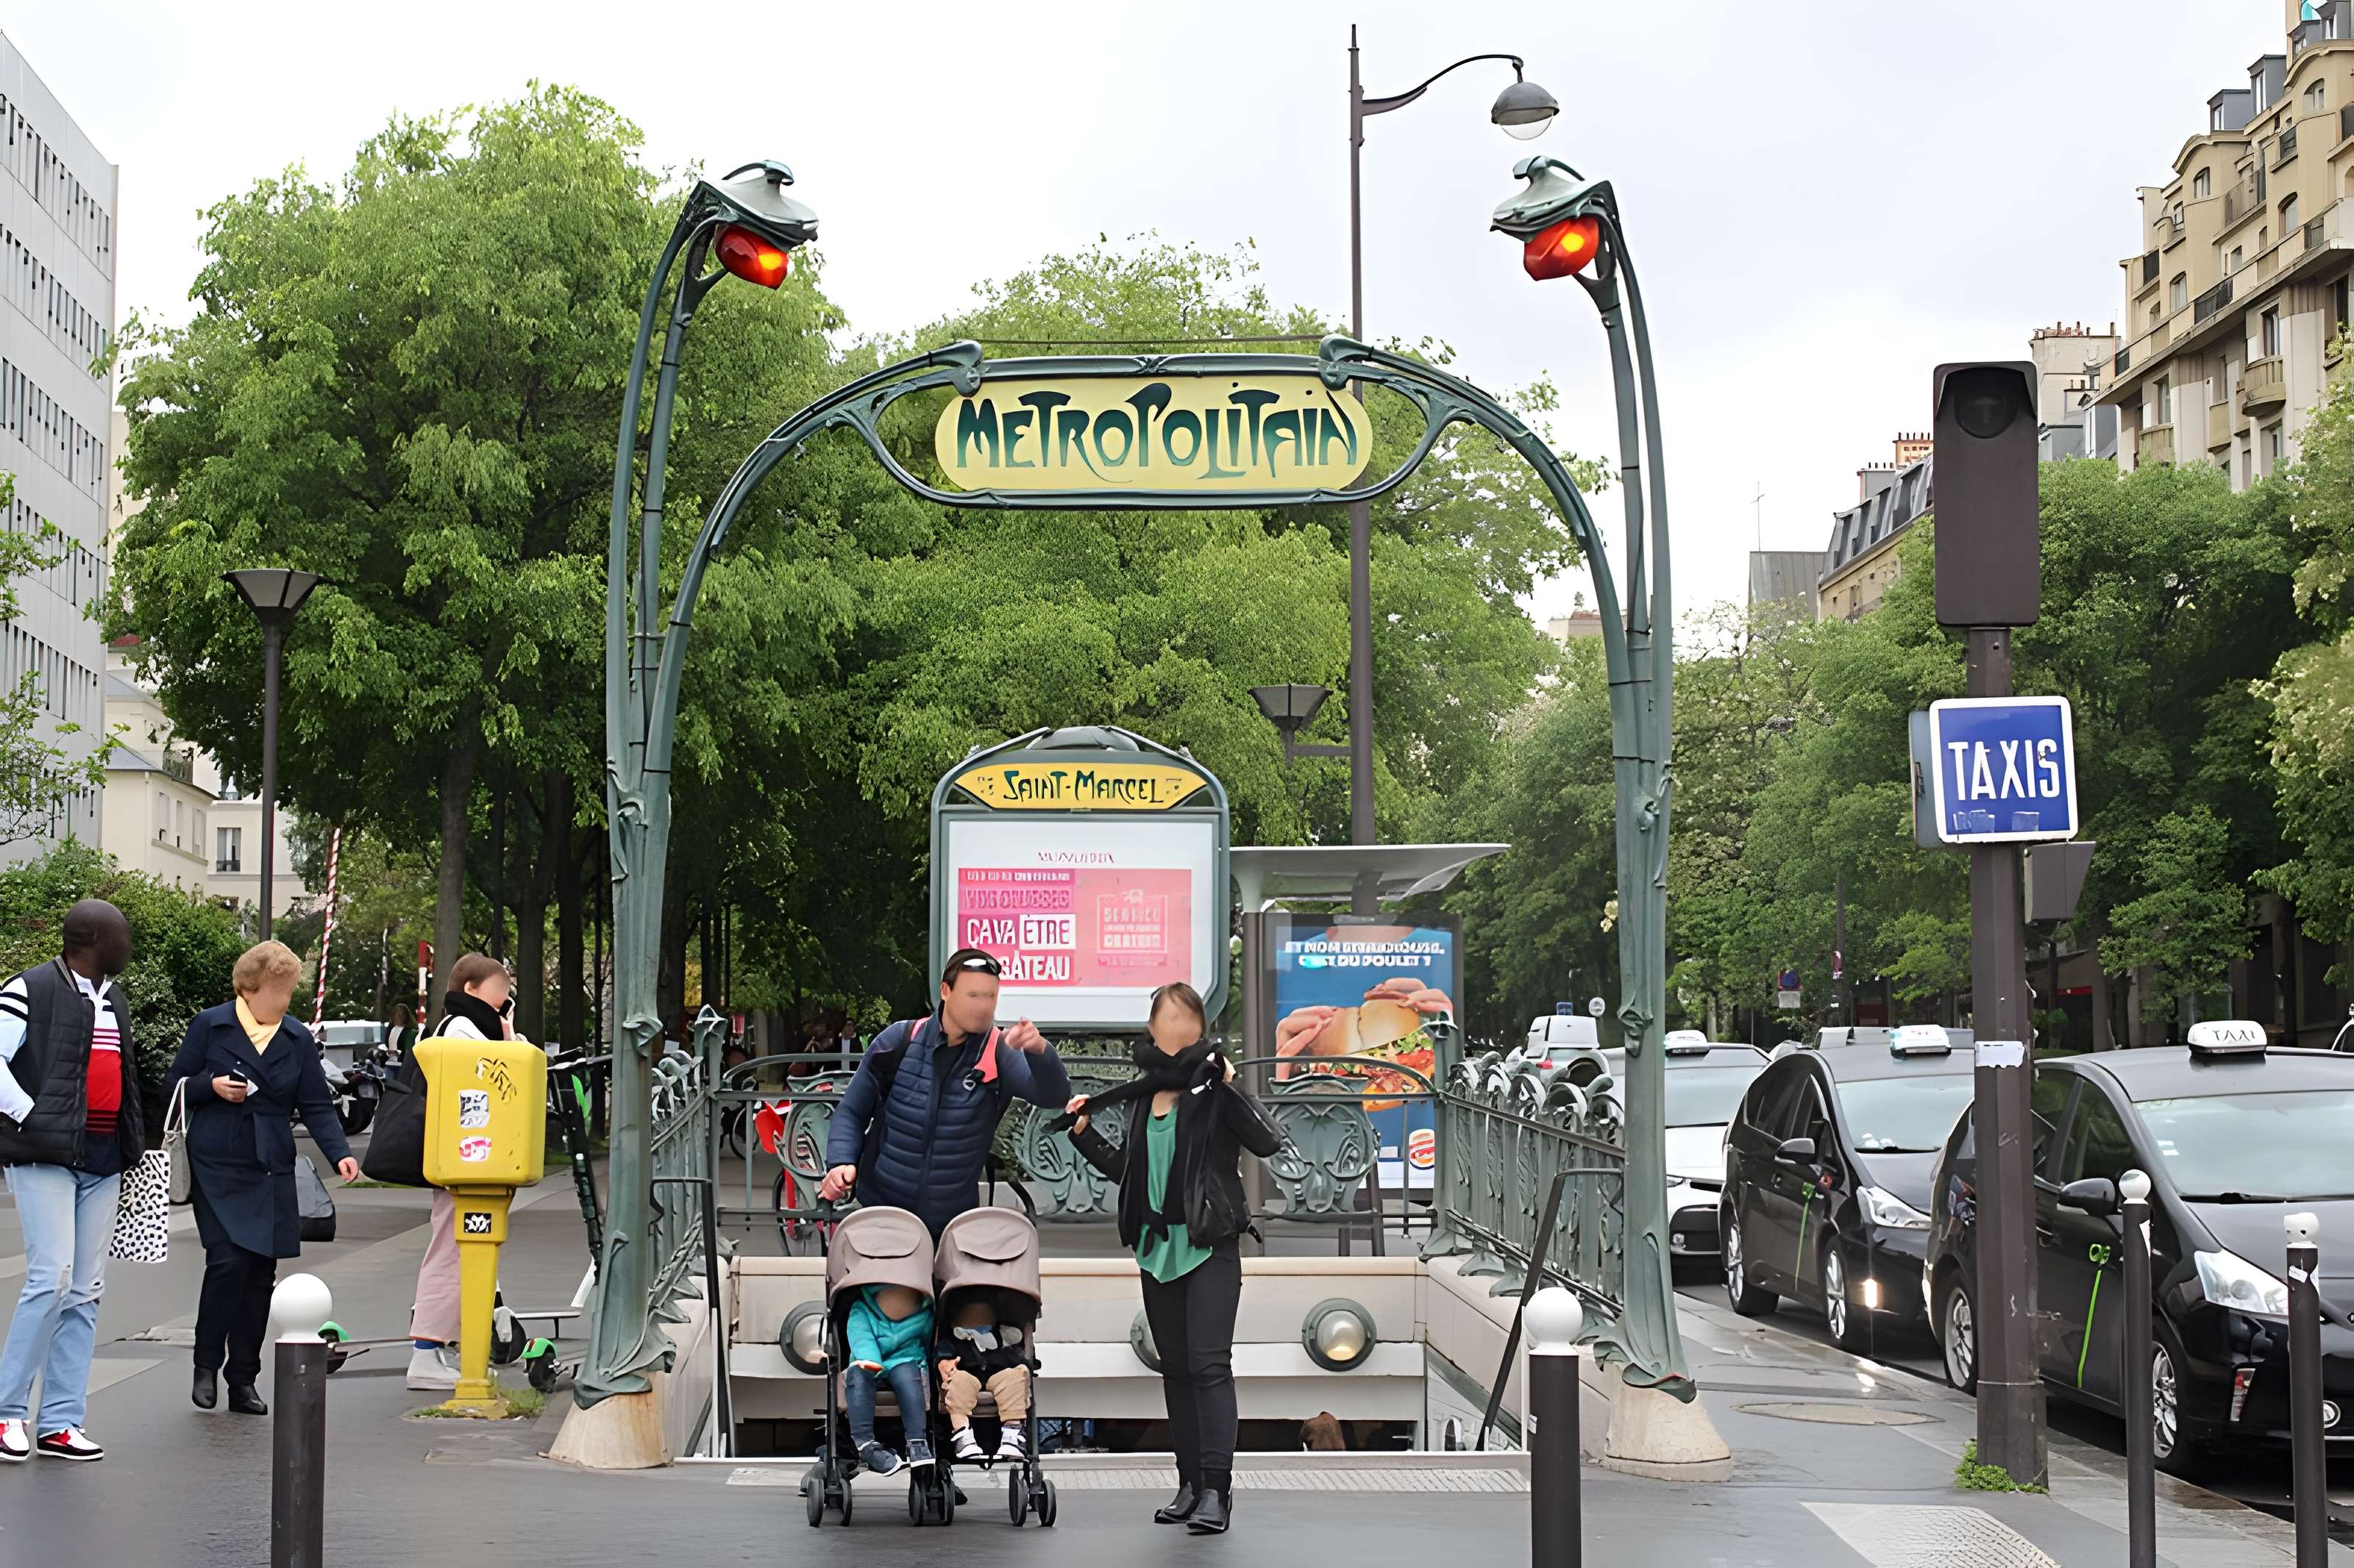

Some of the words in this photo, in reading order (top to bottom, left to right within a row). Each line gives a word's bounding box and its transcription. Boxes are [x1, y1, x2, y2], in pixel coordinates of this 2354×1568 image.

[957, 382, 1356, 483] METROPOLITAIN
[1003, 770, 1164, 804] SAINT-MARCEL
[1948, 738, 2060, 801] TAXIS
